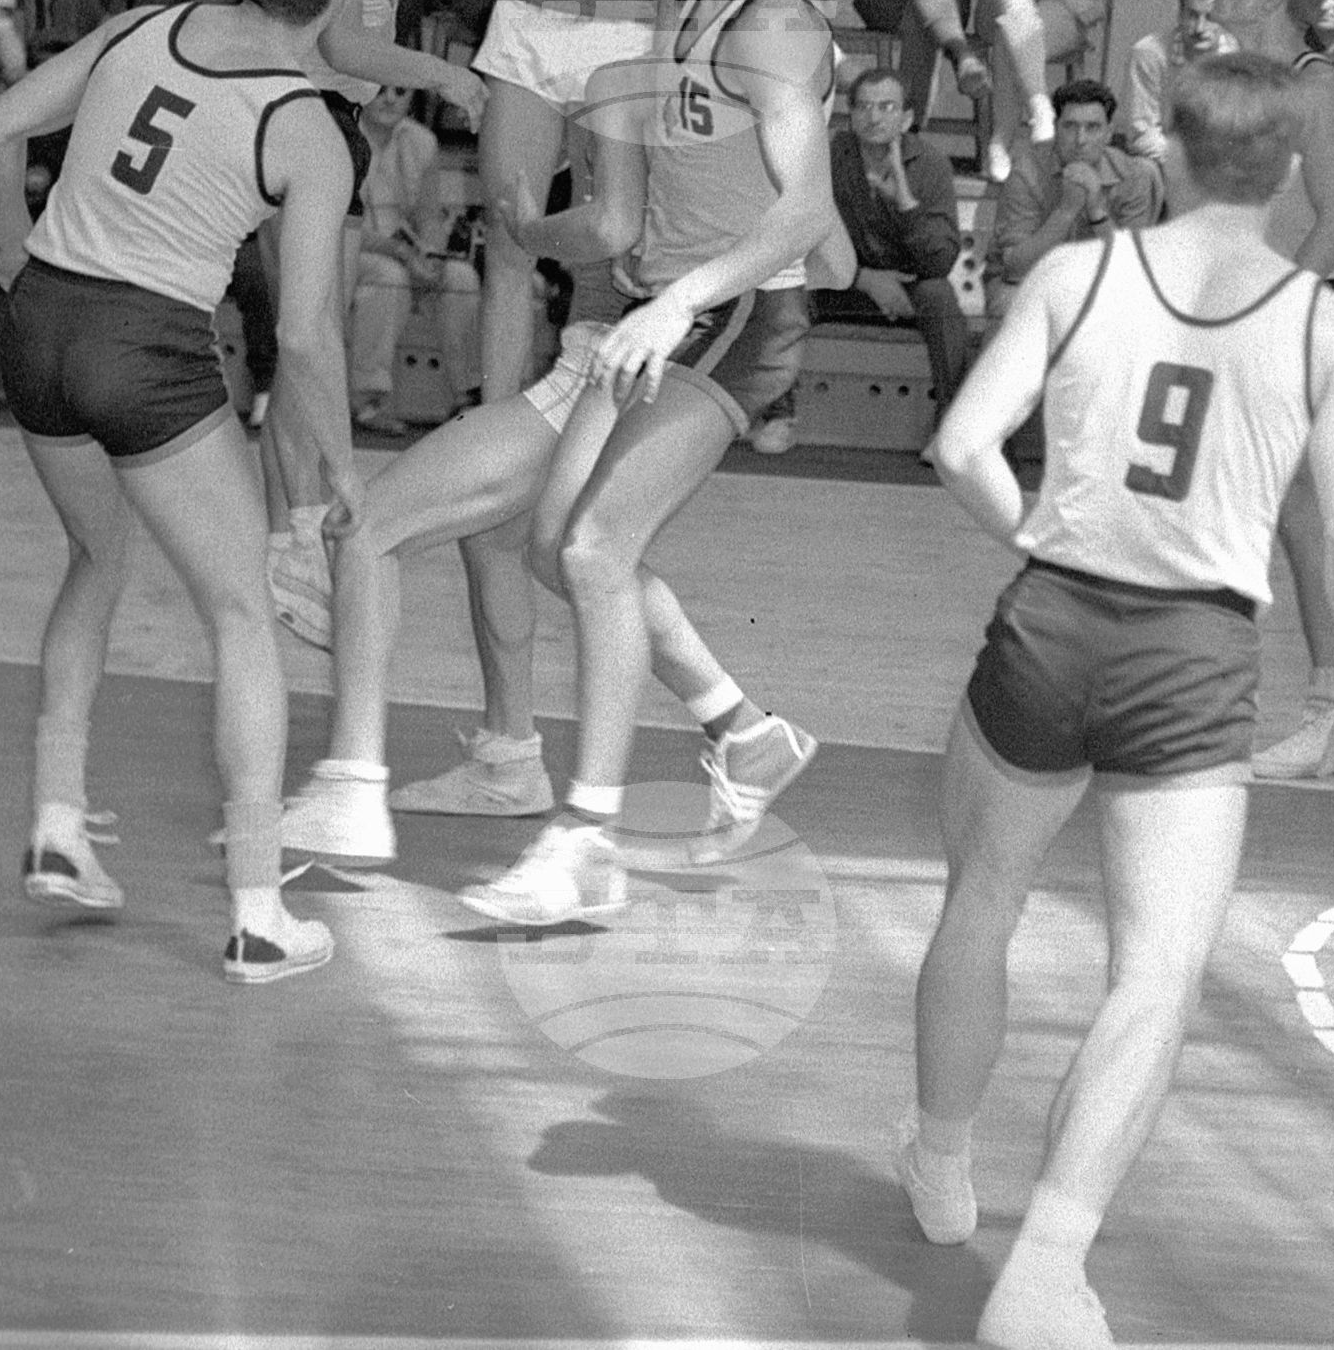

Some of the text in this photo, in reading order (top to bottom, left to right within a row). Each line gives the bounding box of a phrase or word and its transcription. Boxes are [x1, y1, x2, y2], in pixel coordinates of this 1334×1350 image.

[111, 85, 195, 194] 5
[679, 76, 714, 136] 15
[1124, 361, 1214, 503] 9
